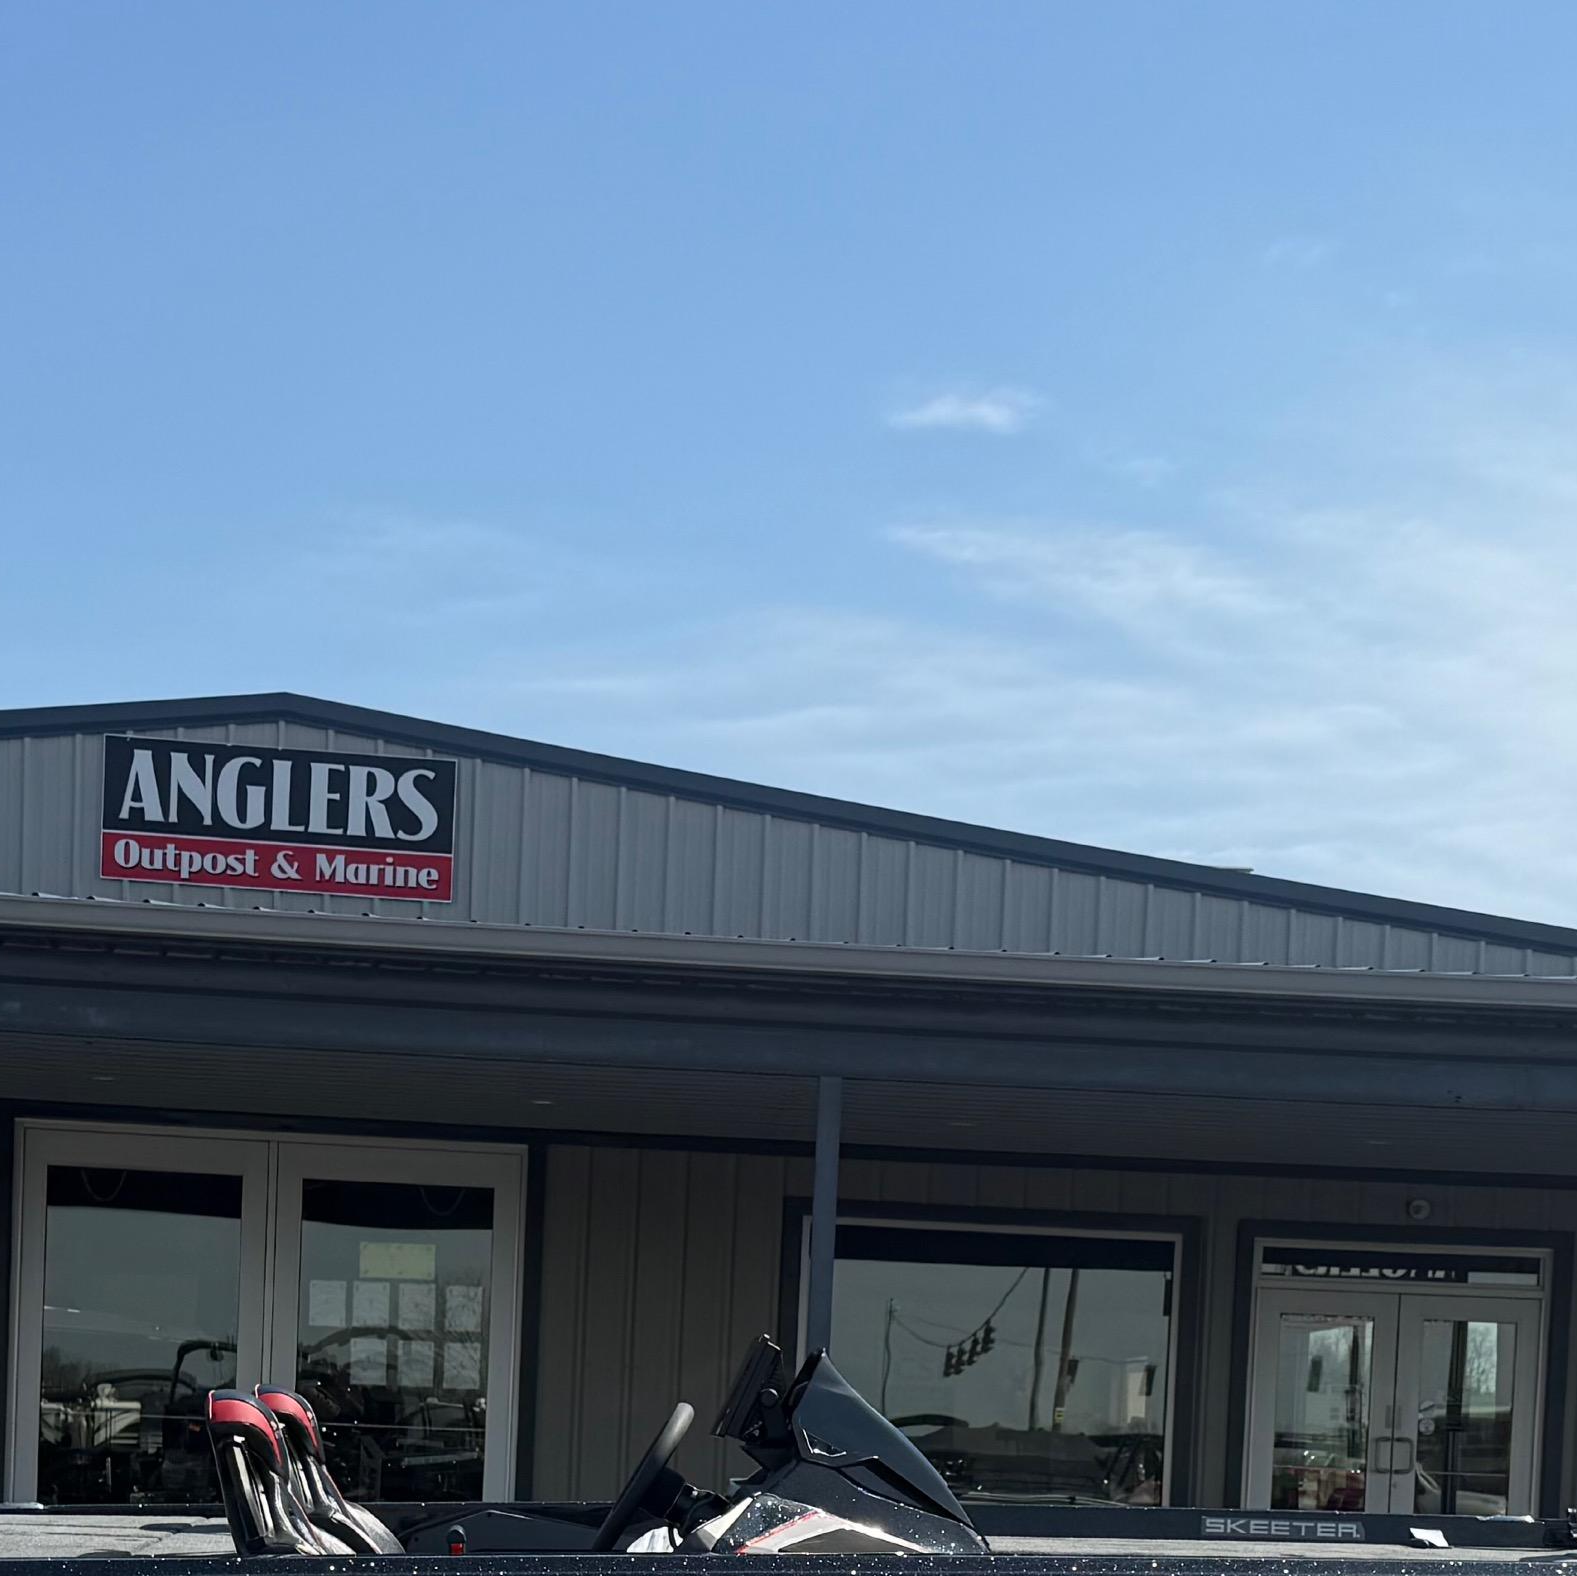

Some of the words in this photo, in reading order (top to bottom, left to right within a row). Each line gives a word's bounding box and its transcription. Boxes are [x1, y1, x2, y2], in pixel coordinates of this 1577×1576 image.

[118, 748, 439, 842] ANGLERS
[113, 838, 259, 880] Outpost
[270, 850, 303, 881] &
[315, 853, 440, 891] Marine
[1205, 1518, 1360, 1539] SKEETER
